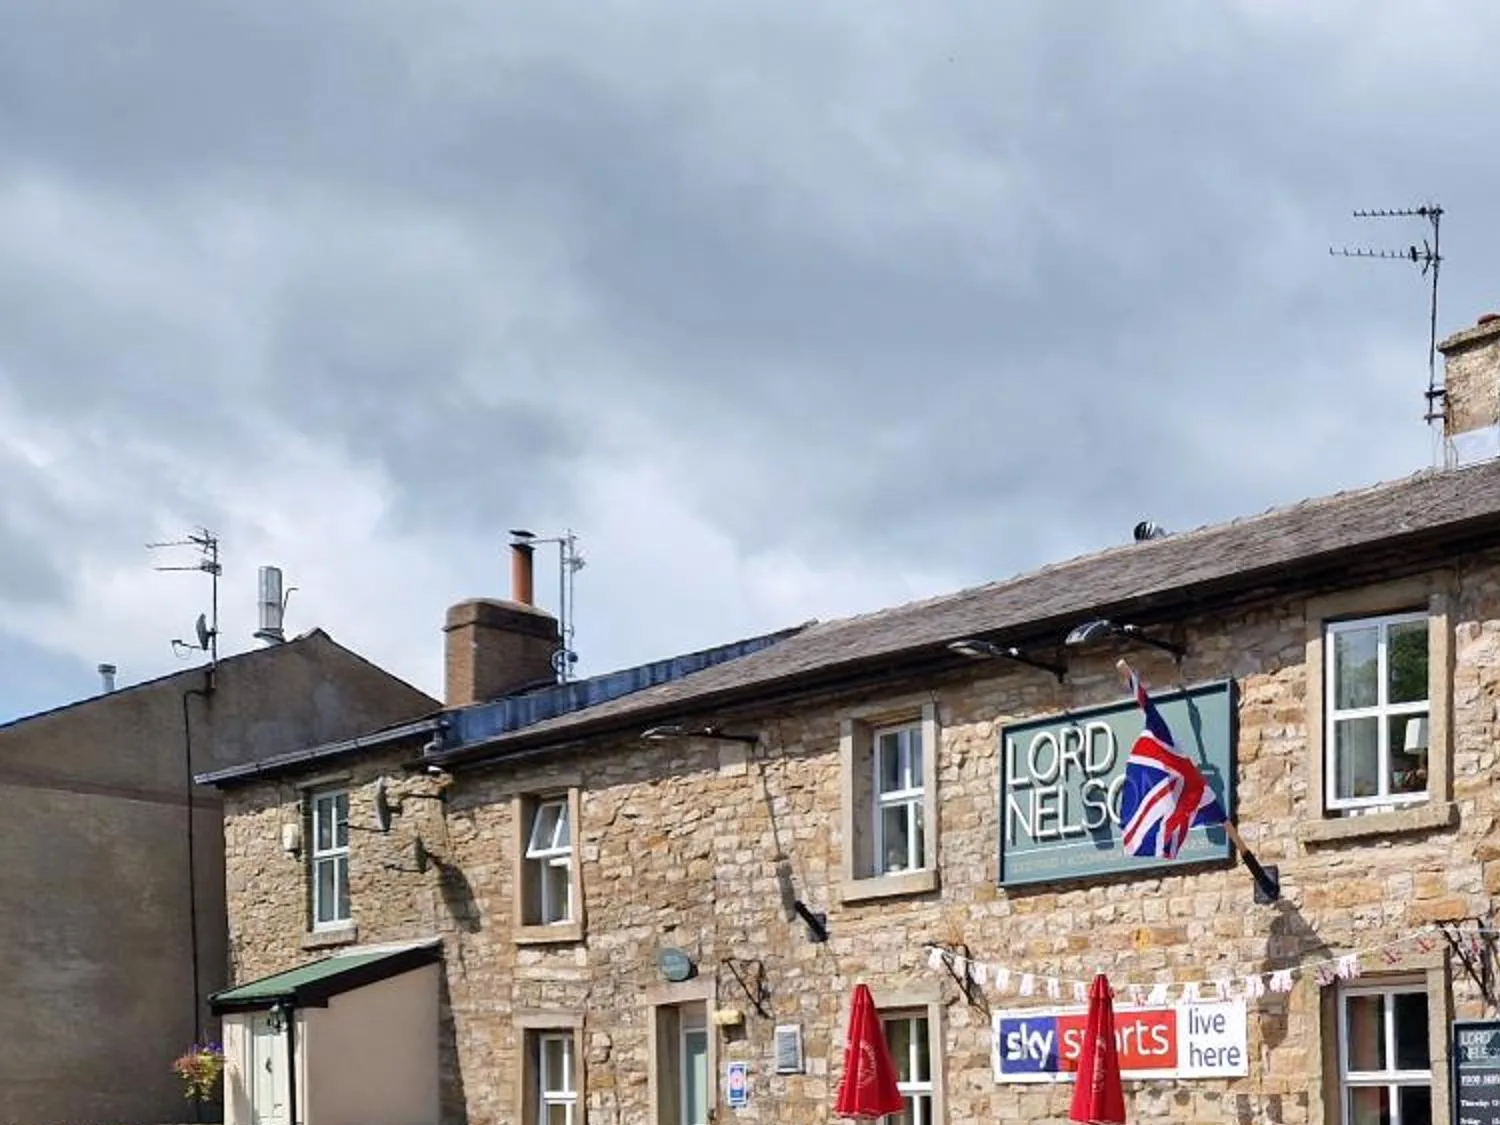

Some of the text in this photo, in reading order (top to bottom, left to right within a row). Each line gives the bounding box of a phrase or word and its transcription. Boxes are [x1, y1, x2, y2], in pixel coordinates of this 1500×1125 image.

[1006, 721, 1116, 785] LORD
[1188, 1008, 1225, 1035] live
[1006, 1023, 1054, 1068] sky
[1188, 1042, 1241, 1067] here
